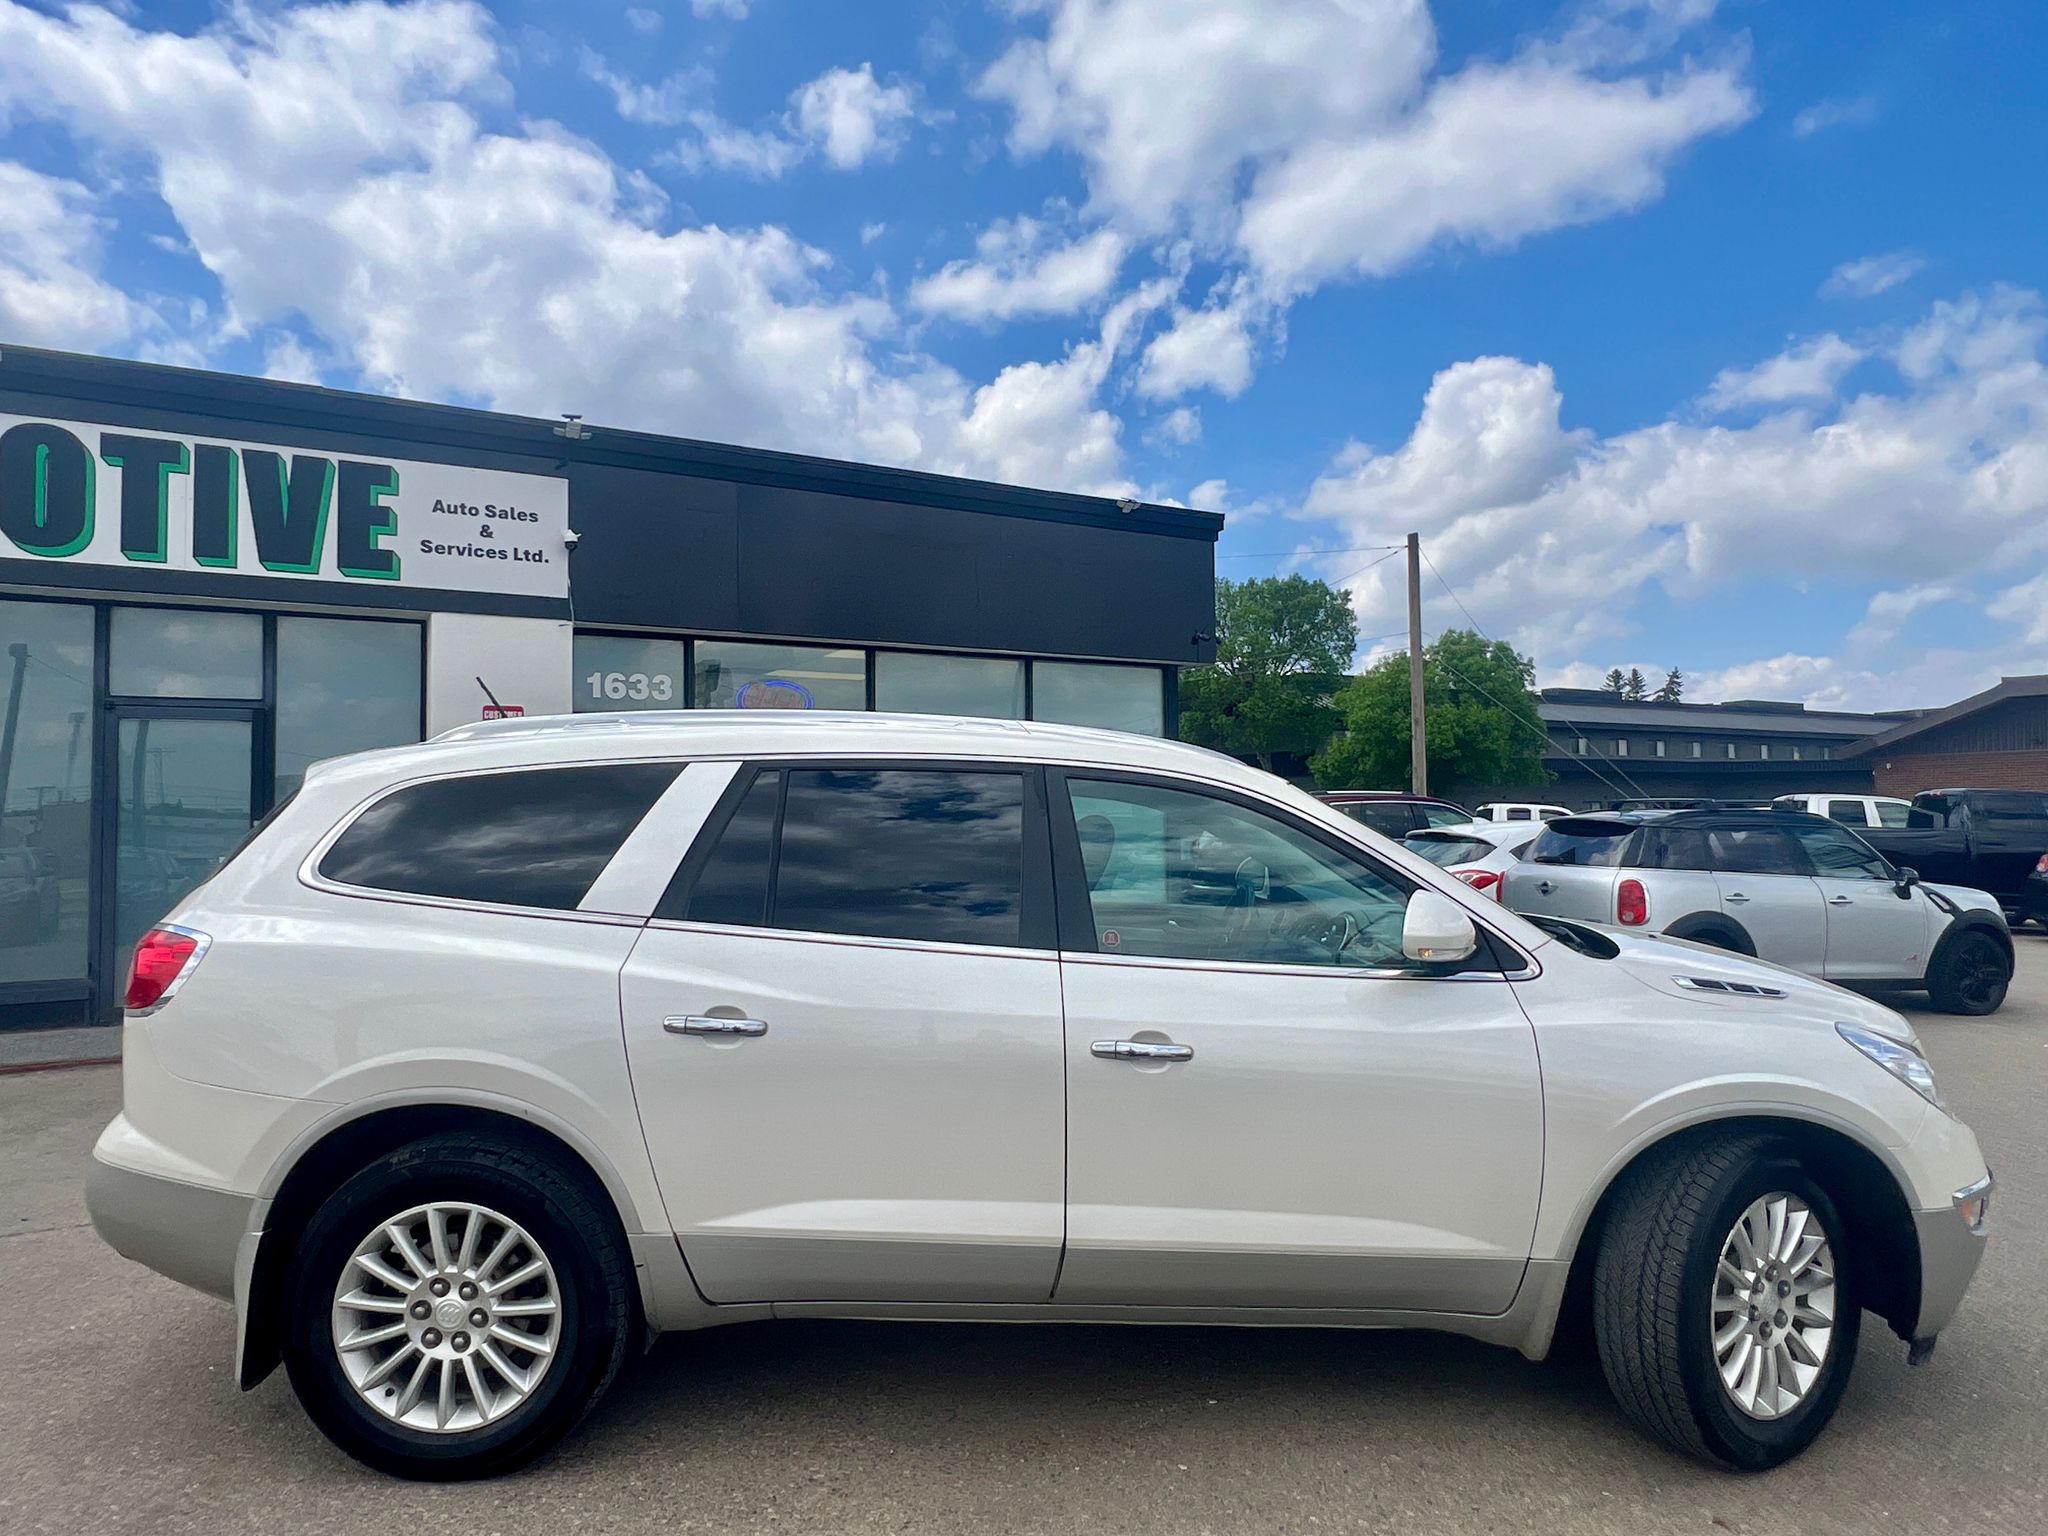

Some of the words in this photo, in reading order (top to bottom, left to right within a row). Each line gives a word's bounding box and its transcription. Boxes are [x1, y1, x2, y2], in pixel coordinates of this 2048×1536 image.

[0, 423, 401, 580] OTIVE
[432, 499, 480, 517] Auto
[484, 505, 539, 523] Sales
[480, 524, 494, 539] &
[420, 539, 508, 560] Services
[513, 547, 549, 563] Ltd.
[586, 672, 673, 701] 1633
